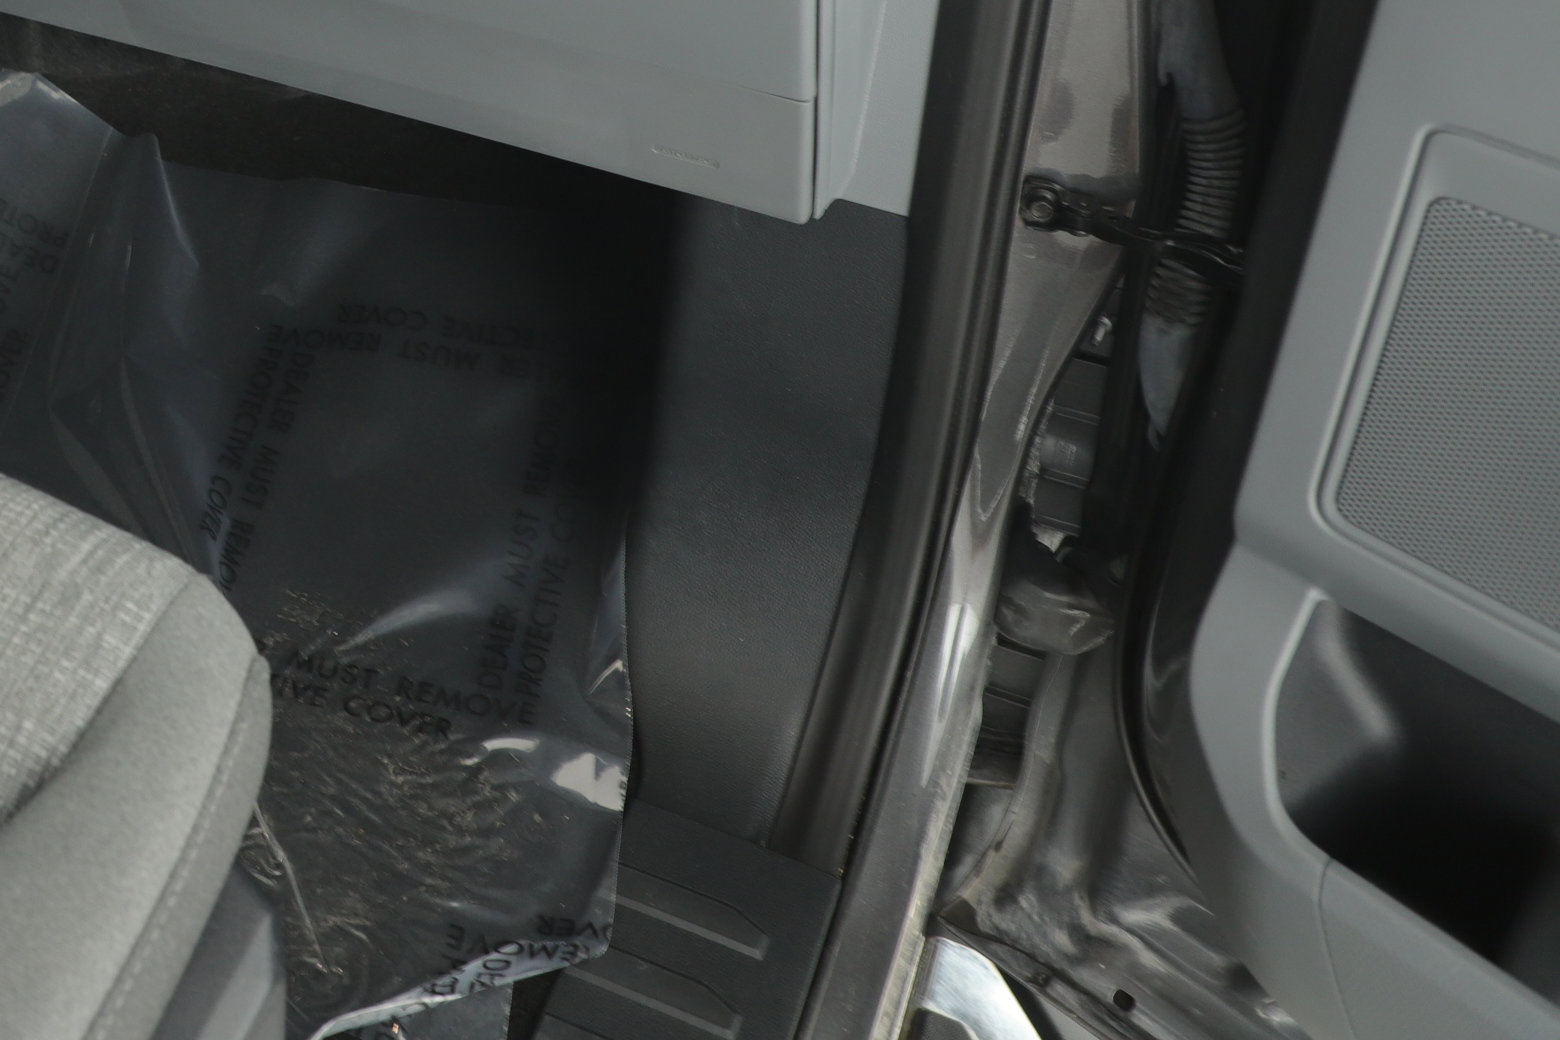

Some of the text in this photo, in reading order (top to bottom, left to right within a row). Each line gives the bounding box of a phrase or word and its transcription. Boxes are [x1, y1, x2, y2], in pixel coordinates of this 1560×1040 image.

[266, 323, 382, 353] REMOVE
[336, 303, 429, 332] COVER
[397, 338, 482, 371] MUST
[269, 350, 316, 434] DEALER
[200, 346, 282, 542] PROTECTIVE COVER
[240, 444, 281, 510] MUST
[477, 602, 521, 692] DEALER
[503, 507, 540, 589] MUST
[514, 551, 570, 698] PROTECTIVE
[291, 650, 381, 690] MUST
[398, 676, 536, 724] REMOVE
[343, 694, 452, 739] COVER
